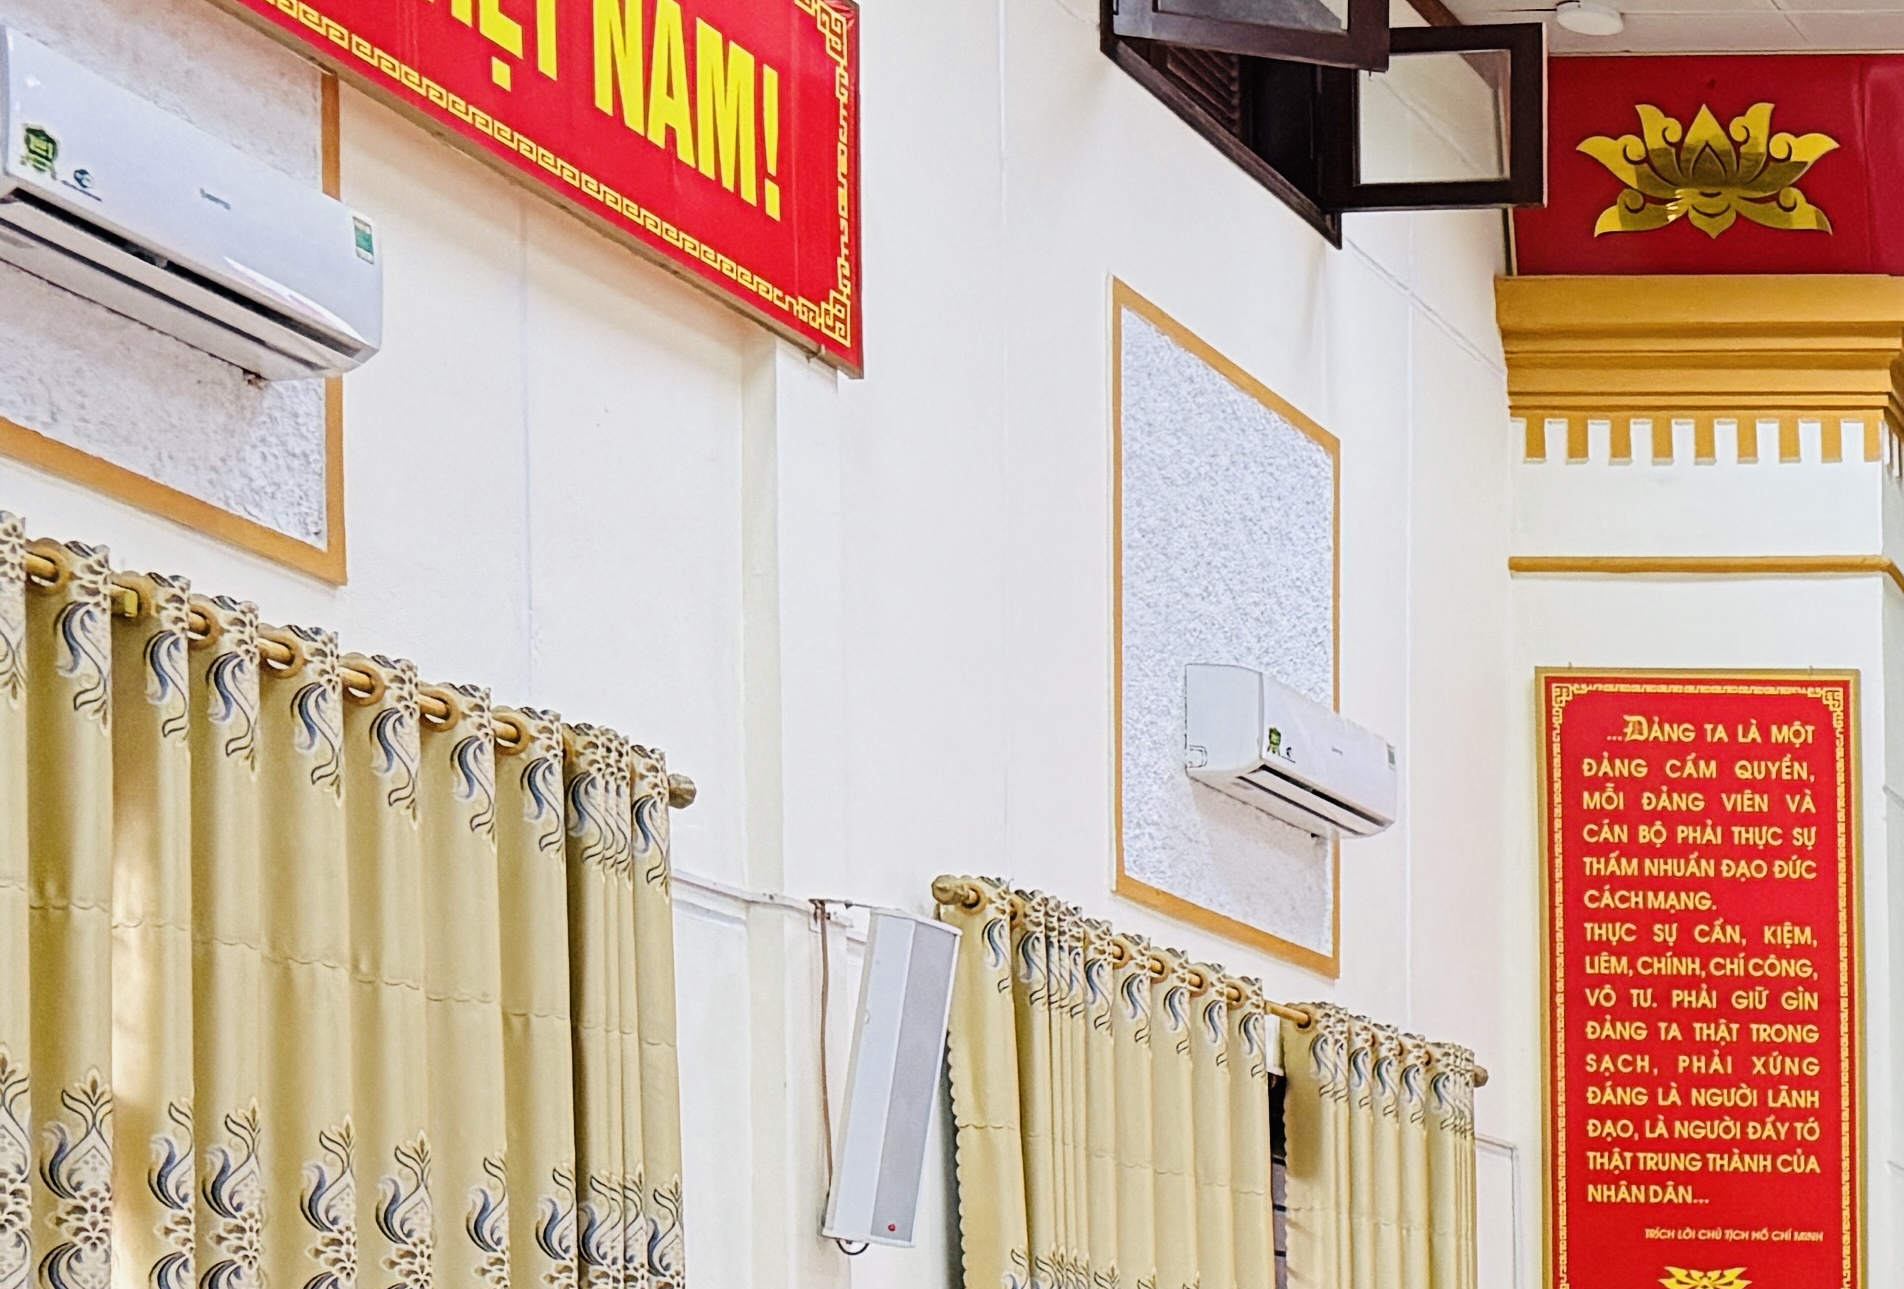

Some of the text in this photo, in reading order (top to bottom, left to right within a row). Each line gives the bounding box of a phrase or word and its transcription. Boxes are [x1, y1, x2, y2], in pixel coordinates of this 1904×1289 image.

[593, 0, 780, 221] NAM!
[1704, 724, 1728, 742] TA
[1738, 719, 1761, 743] LÀ
[1771, 721, 1815, 747] MỘT
[1583, 783, 1816, 813] MỖI ĐẢNG VIÊN VÀ
[1583, 819, 1816, 850] CÁN BỘ PHẢI THỰC SỰ
[1584, 885, 1716, 913] CÁCH MẠNG.
[1585, 952, 1818, 980] LIÊM, CHÍNH, CHÍ CÔNG,
[1585, 984, 1818, 1010] VÔ TƯ. PHẢI GIỮ GÌN
[1586, 1015, 1819, 1045] ĐẢNG TA THẬT TRONG
[1586, 1049, 1820, 1076] SẠCH, PHẢI XỨNG
[1586, 1081, 1819, 1108] ĐÁNG LÀ NGƯỜI LÃNH
[1587, 1148, 1820, 1174] THẬT TRUNG THÀNH CỦA
[1588, 1181, 1645, 1203] NHÂN
